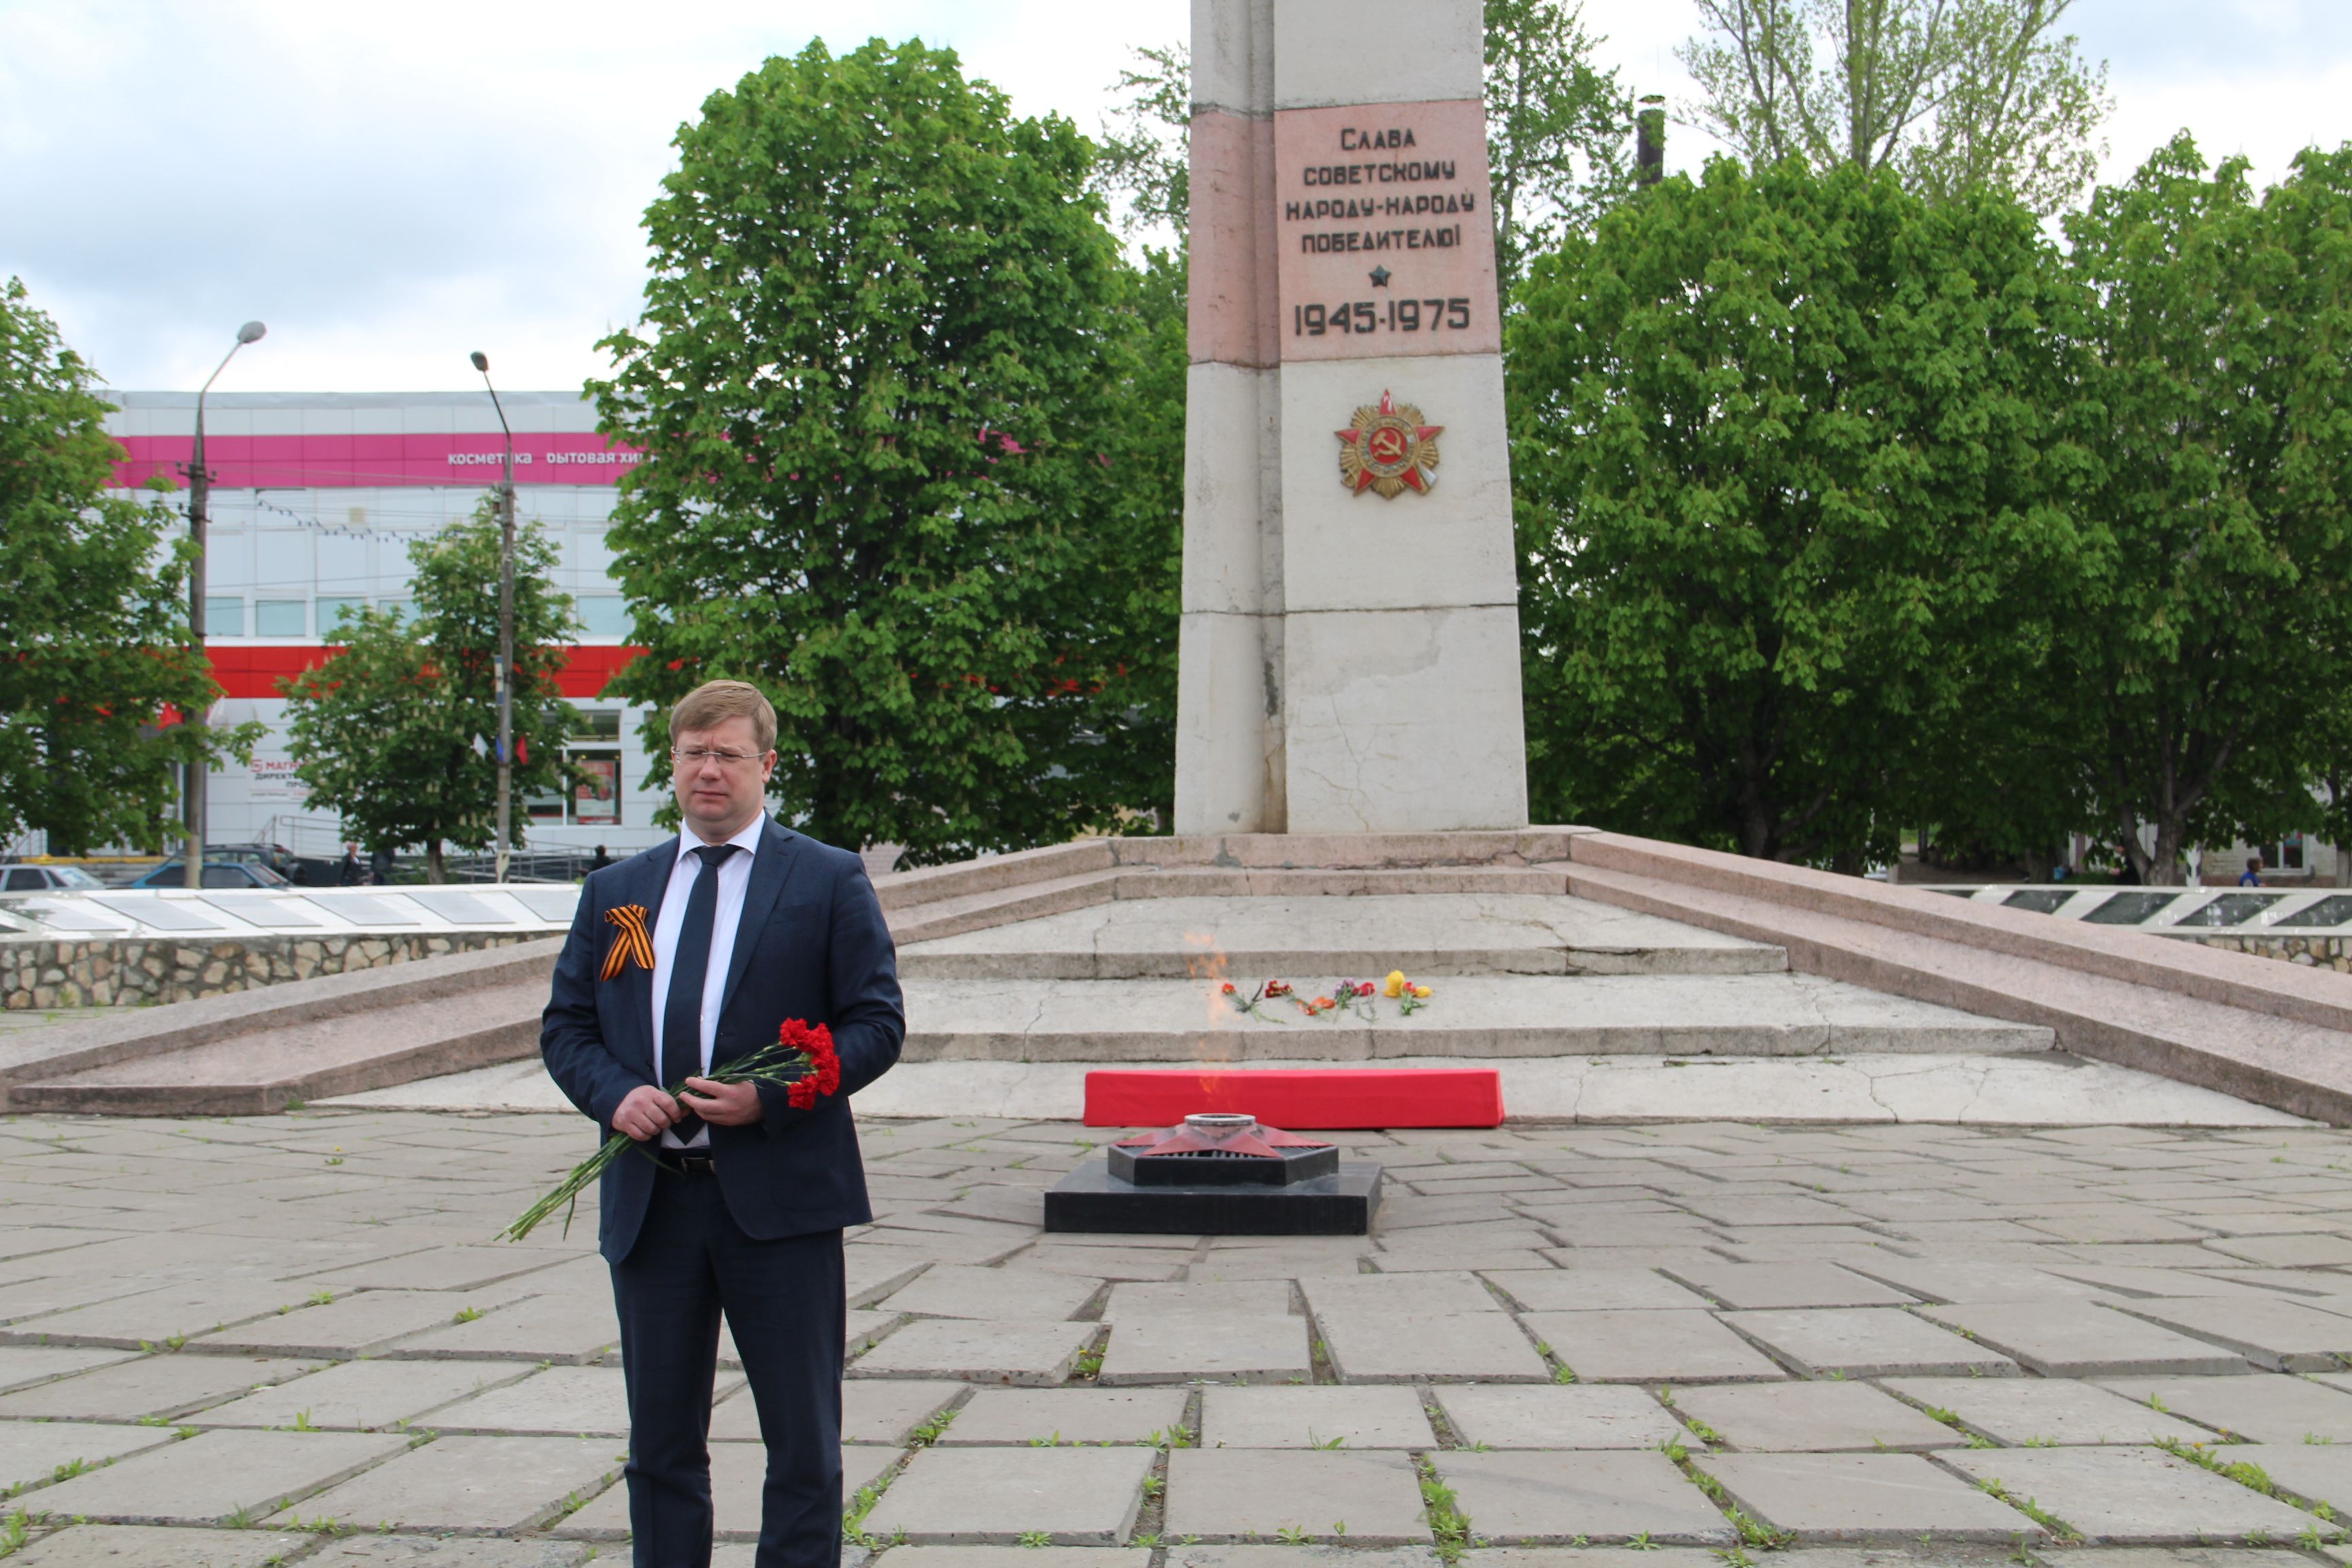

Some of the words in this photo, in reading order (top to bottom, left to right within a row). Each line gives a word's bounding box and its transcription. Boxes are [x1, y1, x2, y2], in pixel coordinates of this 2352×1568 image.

[1341, 128, 1416, 150] СЛАВА
[1303, 161, 1455, 186] СОВЕТСКОМУ
[1286, 194, 1475, 220] НАРОДУ-НАРОДУ
[1302, 224, 1460, 253] ПОБЕДИТЕЛЮ!
[1295, 297, 1470, 336] 1945-1975
[448, 453, 533, 464] косметка
